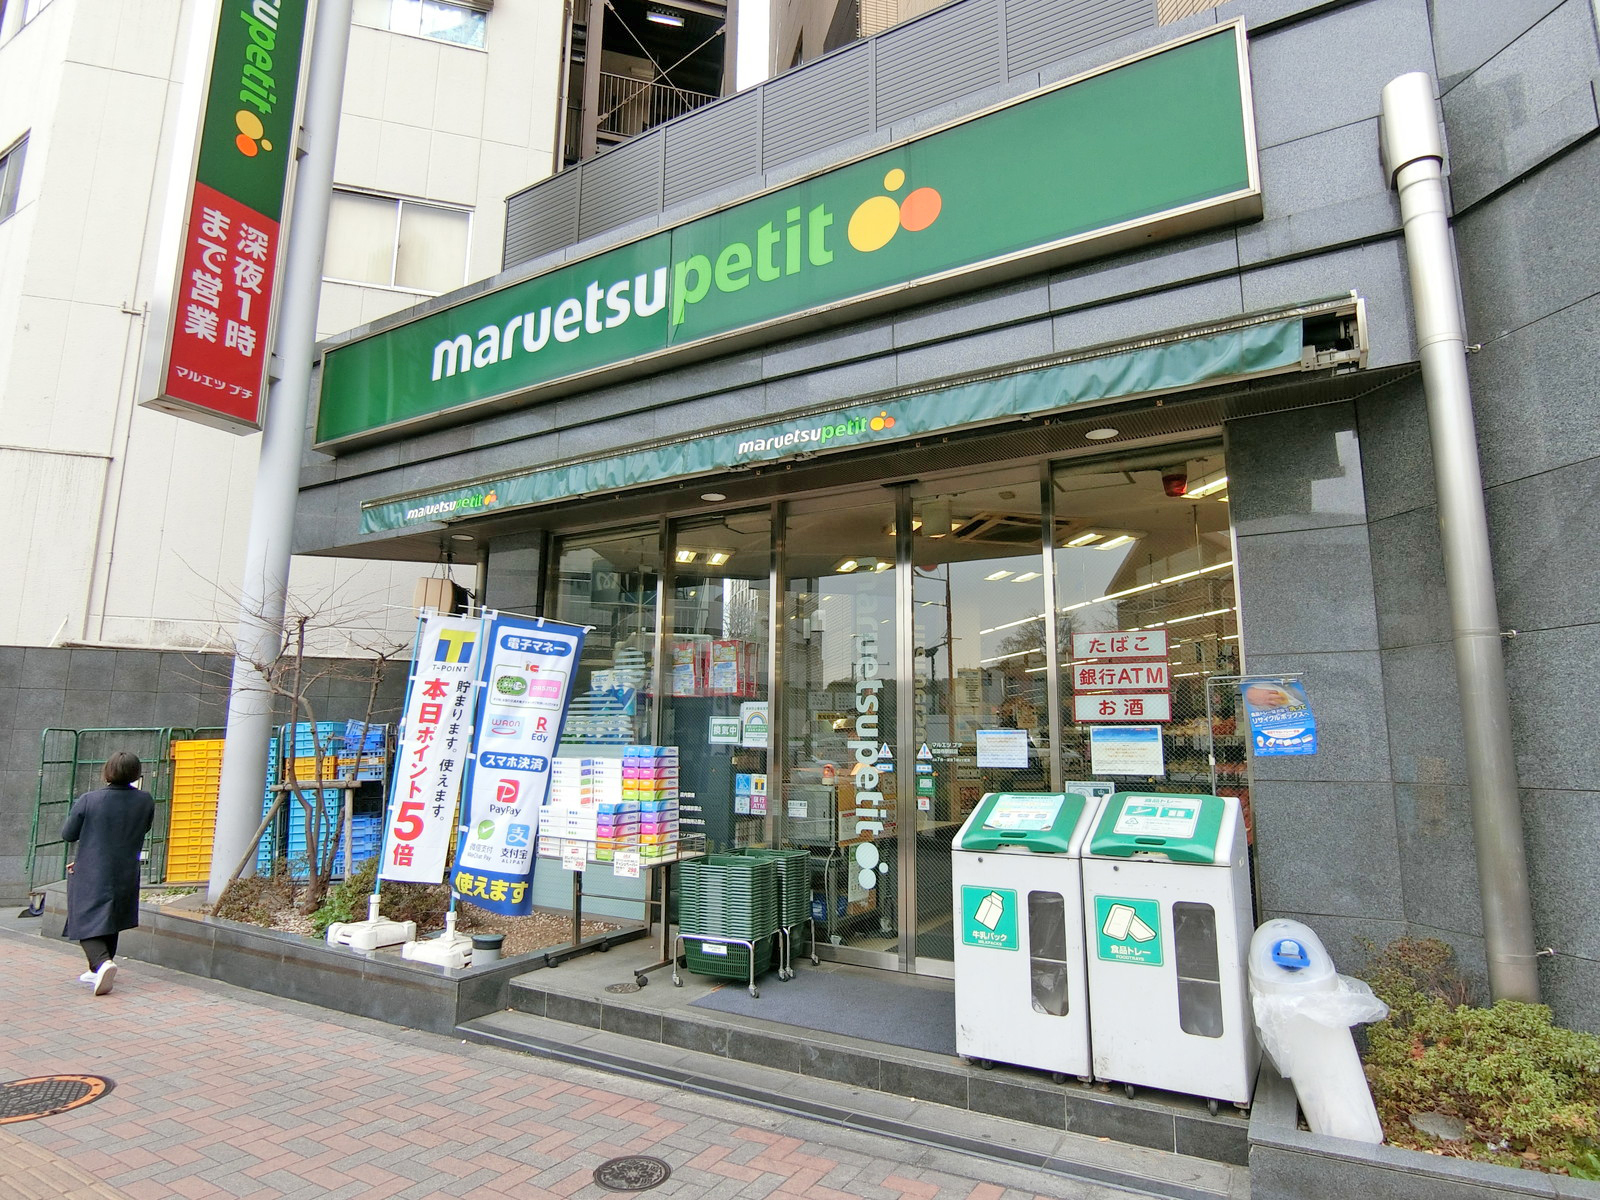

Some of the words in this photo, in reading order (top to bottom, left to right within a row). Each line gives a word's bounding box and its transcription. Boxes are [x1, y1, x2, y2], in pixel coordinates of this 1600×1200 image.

[185, 206, 231, 343] まで営業
[225, 222, 269, 357] 深夜1時
[507, 637, 565, 653] 電子マネー
[1088, 636, 1149, 654] たばこ
[432, 665, 468, 673] T-POINT
[1079, 667, 1163, 685] 銀行ATM
[1098, 699, 1144, 716] お酒
[531, 731, 548, 743] Edy
[485, 754, 544, 771] スマホ決済
[489, 804, 522, 817] PayPay
[455, 871, 529, 904] 使えます
[972, 930, 1007, 941] 牛乳パック
[1110, 944, 1151, 956] 食品トレー
